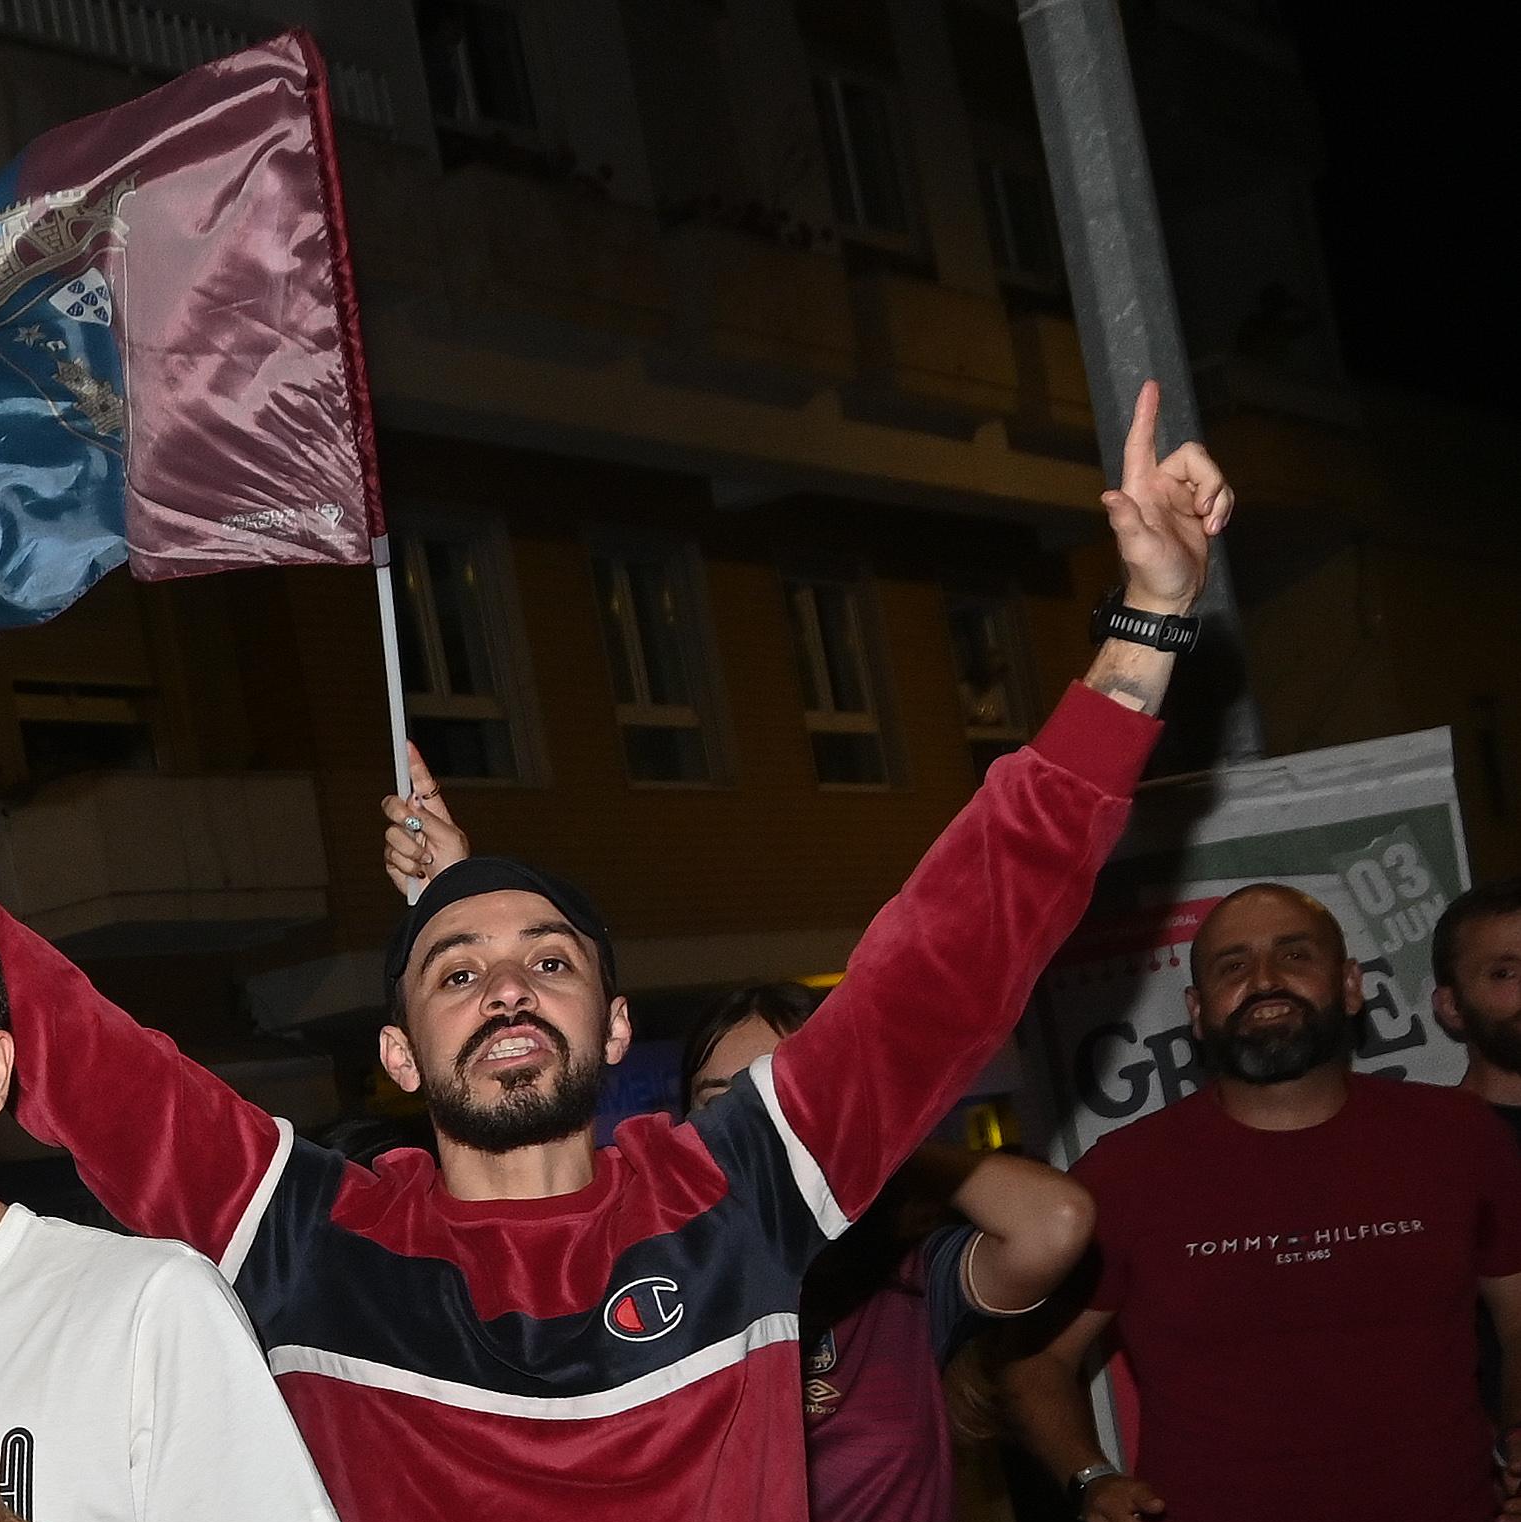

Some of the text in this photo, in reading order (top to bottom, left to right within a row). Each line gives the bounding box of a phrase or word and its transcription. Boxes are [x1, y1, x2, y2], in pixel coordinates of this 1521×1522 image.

[1346, 842, 1431, 918] 03
[1075, 957, 1427, 1118] GRE
[1185, 1218, 1424, 1258] TOMMY HILFIGER
